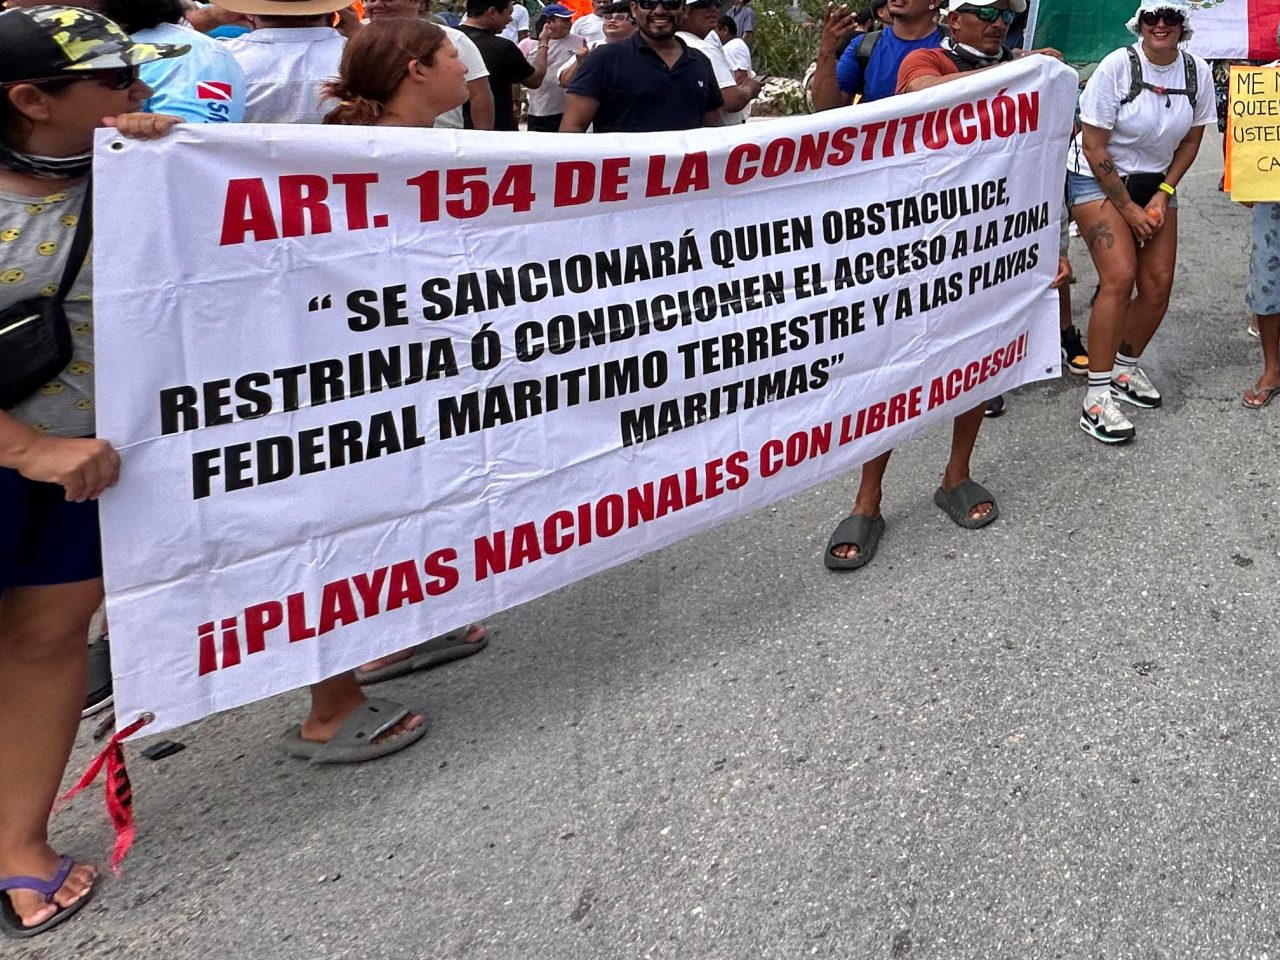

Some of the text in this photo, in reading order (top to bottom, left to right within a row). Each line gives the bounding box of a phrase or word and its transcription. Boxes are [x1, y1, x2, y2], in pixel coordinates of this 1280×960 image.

[221, 89, 1038, 245] ART. 154 DE LA CONSTITUCIÓN
[1237, 72, 1265, 95] ME
[160, 197, 1048, 435] RESTRINJA Ó CONDICIONEN EL ACCESO A LA ZONA
[422, 229, 702, 321] SANCIONARÁ
[710, 216, 813, 268] QUIEN
[823, 177, 1009, 244] OBSTACULICE,
[193, 243, 1038, 499] FEDERAL MARITIMO TERRESTRE Y A LAS PLAYAS
[475, 451, 748, 580] NACIONALES
[760, 423, 831, 477] CON
[840, 387, 922, 445] LIBRE
[927, 330, 1029, 410] ACCESO!!
